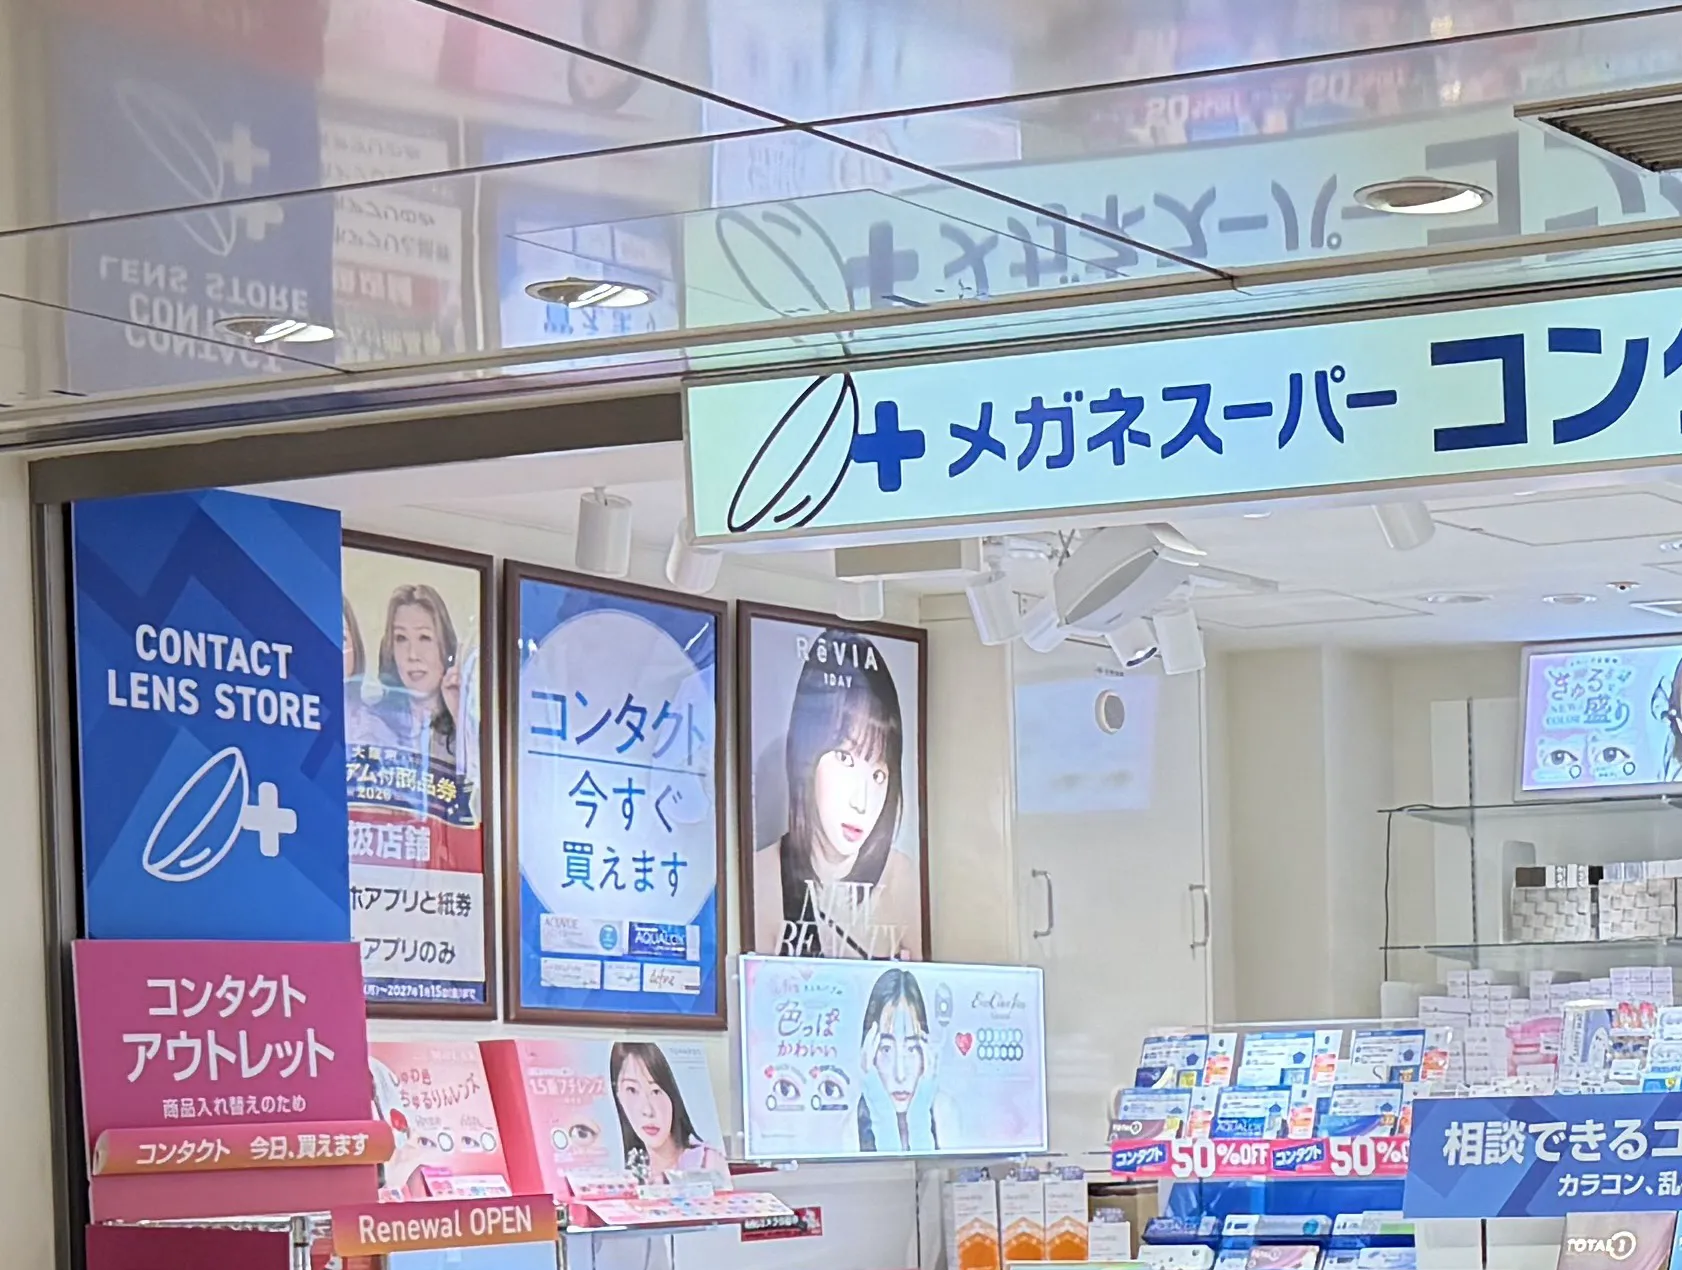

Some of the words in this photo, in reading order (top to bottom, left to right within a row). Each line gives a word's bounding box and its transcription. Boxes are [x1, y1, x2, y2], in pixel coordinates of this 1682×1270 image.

[949, 365, 1397, 478] メガネスーパー
[135, 623, 293, 680] CONTACT
[107, 668, 200, 716] LENS
[214, 683, 322, 731] STORE
[530, 690, 706, 767] コンタクト
[567, 769, 683, 834] 今すぐ
[561, 840, 689, 898] 買えます
[146, 974, 307, 1019] コンタクト
[122, 1028, 336, 1083] アウトレット
[162, 1094, 307, 1120] 商品入れ替えのため
[136, 1137, 231, 1166] コンタクト
[249, 1132, 370, 1161] 今日、買えます
[1115, 1145, 1164, 1169] コンタクト
[1170, 1137, 1270, 1178] 50%OFF
[1275, 1143, 1324, 1169] コンタクト
[358, 1215, 463, 1245] Renewal
[470, 1205, 533, 1236] OPEN
